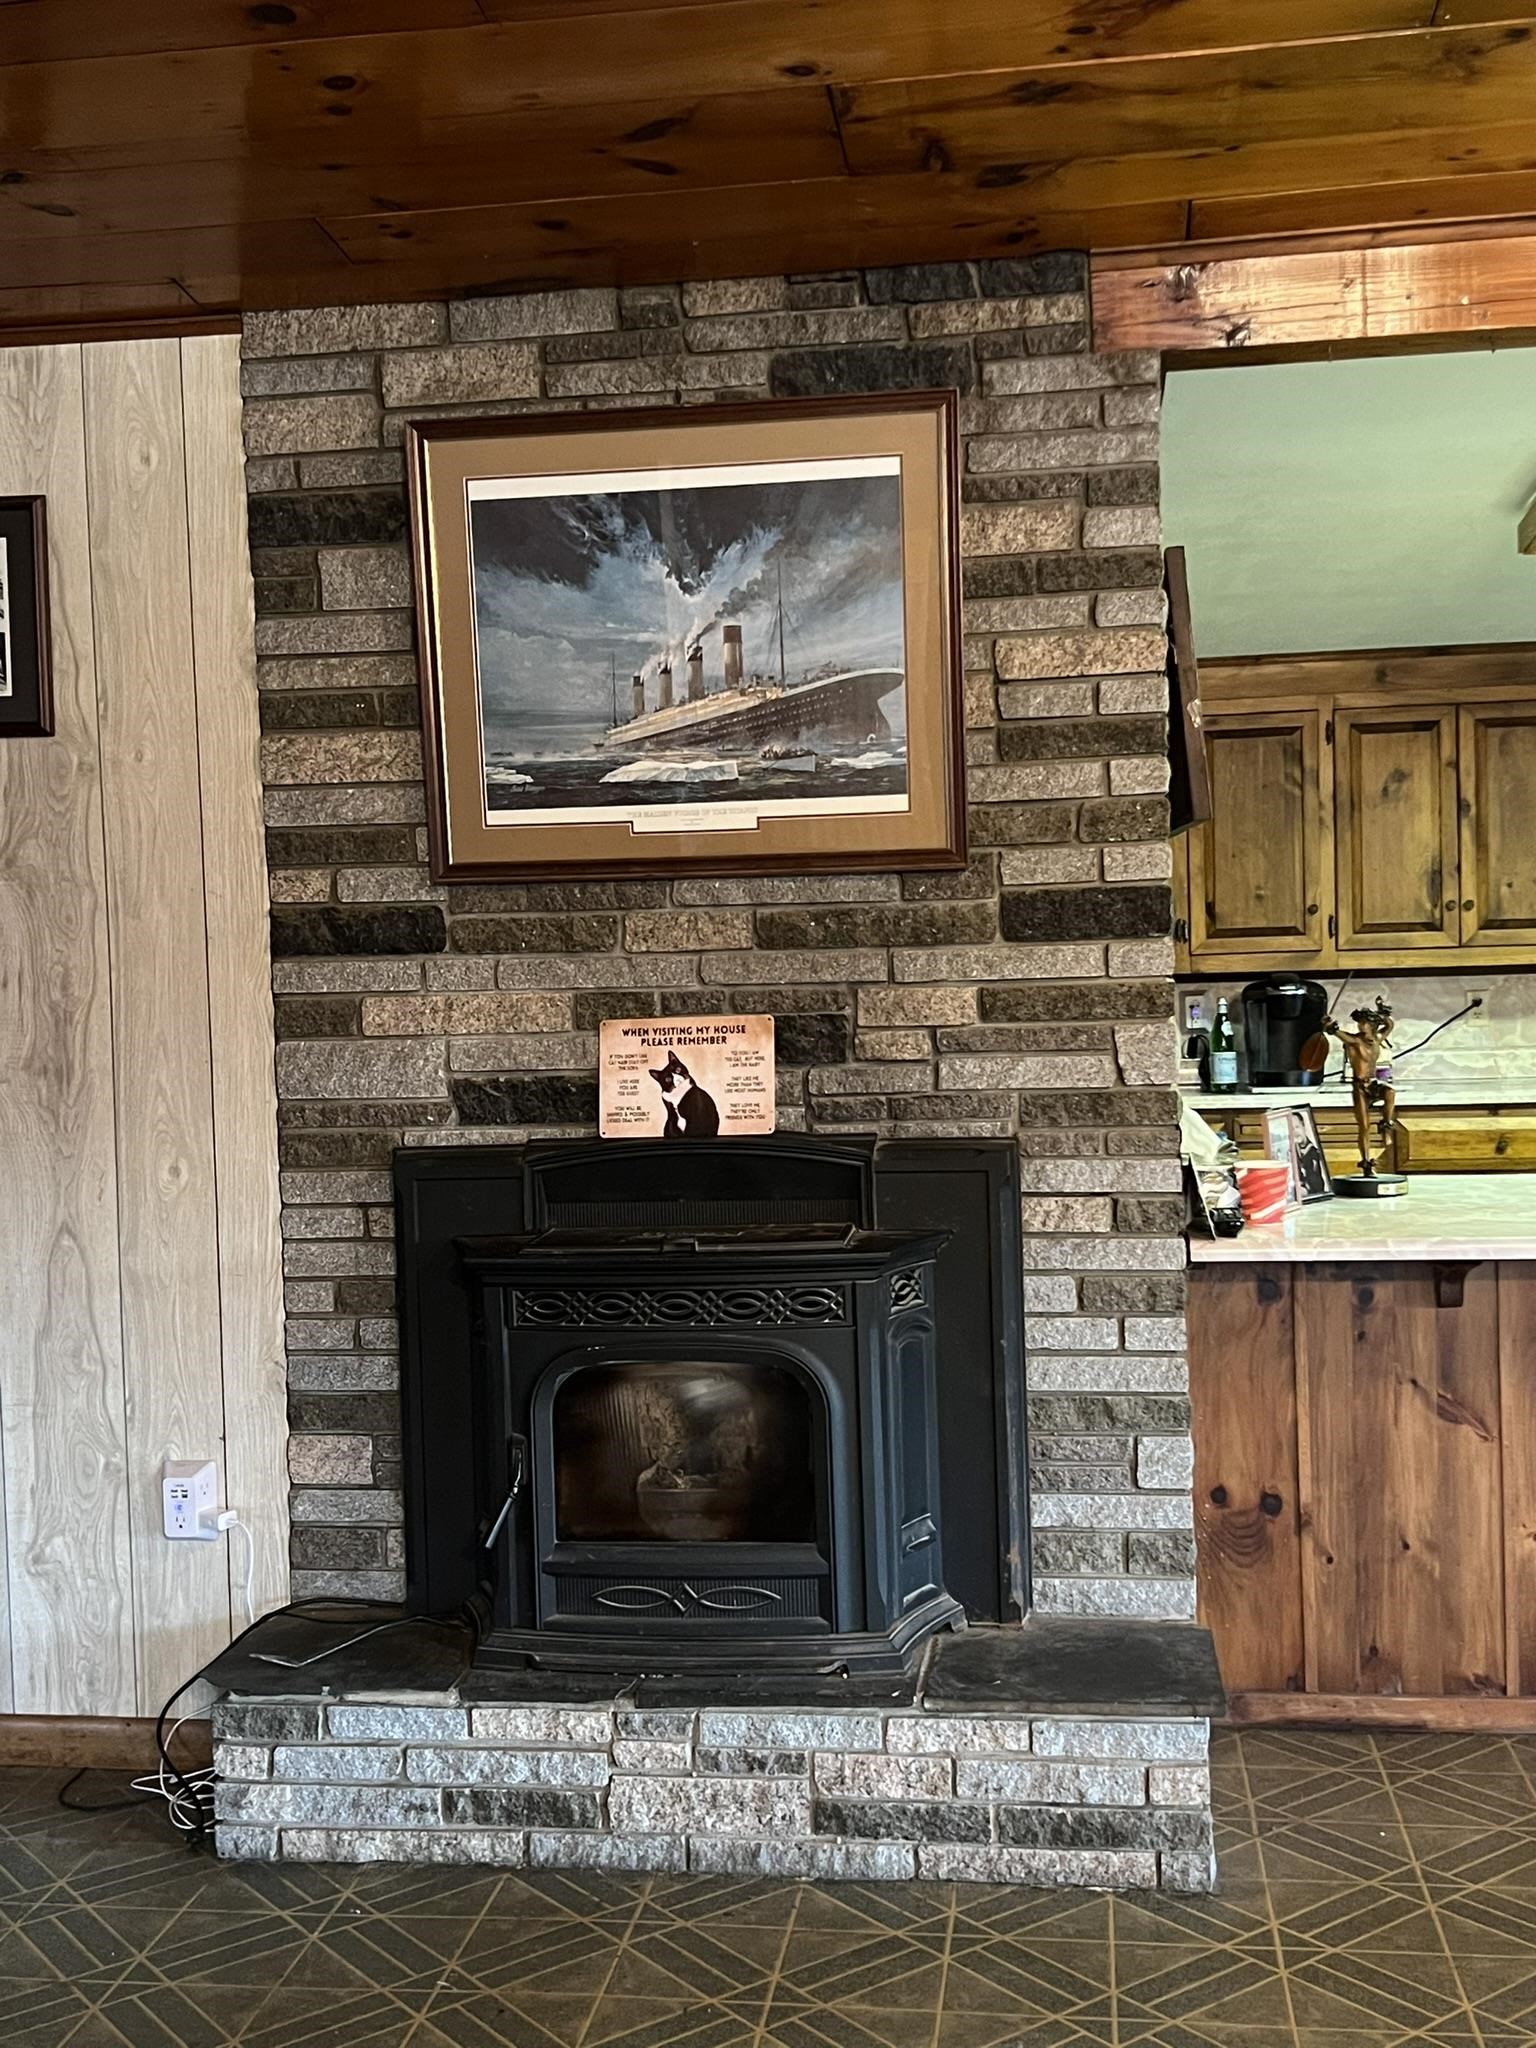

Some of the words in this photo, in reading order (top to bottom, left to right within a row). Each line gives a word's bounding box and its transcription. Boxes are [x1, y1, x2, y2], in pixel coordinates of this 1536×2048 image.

[622, 1028, 649, 1036] WHEN
[653, 1027, 692, 1036] VISITING
[696, 1026, 710, 1034] MY
[714, 1025, 746, 1034] HOUSE
[641, 1037, 673, 1046] PLEASE
[677, 1036, 727, 1045] REMEMBER
